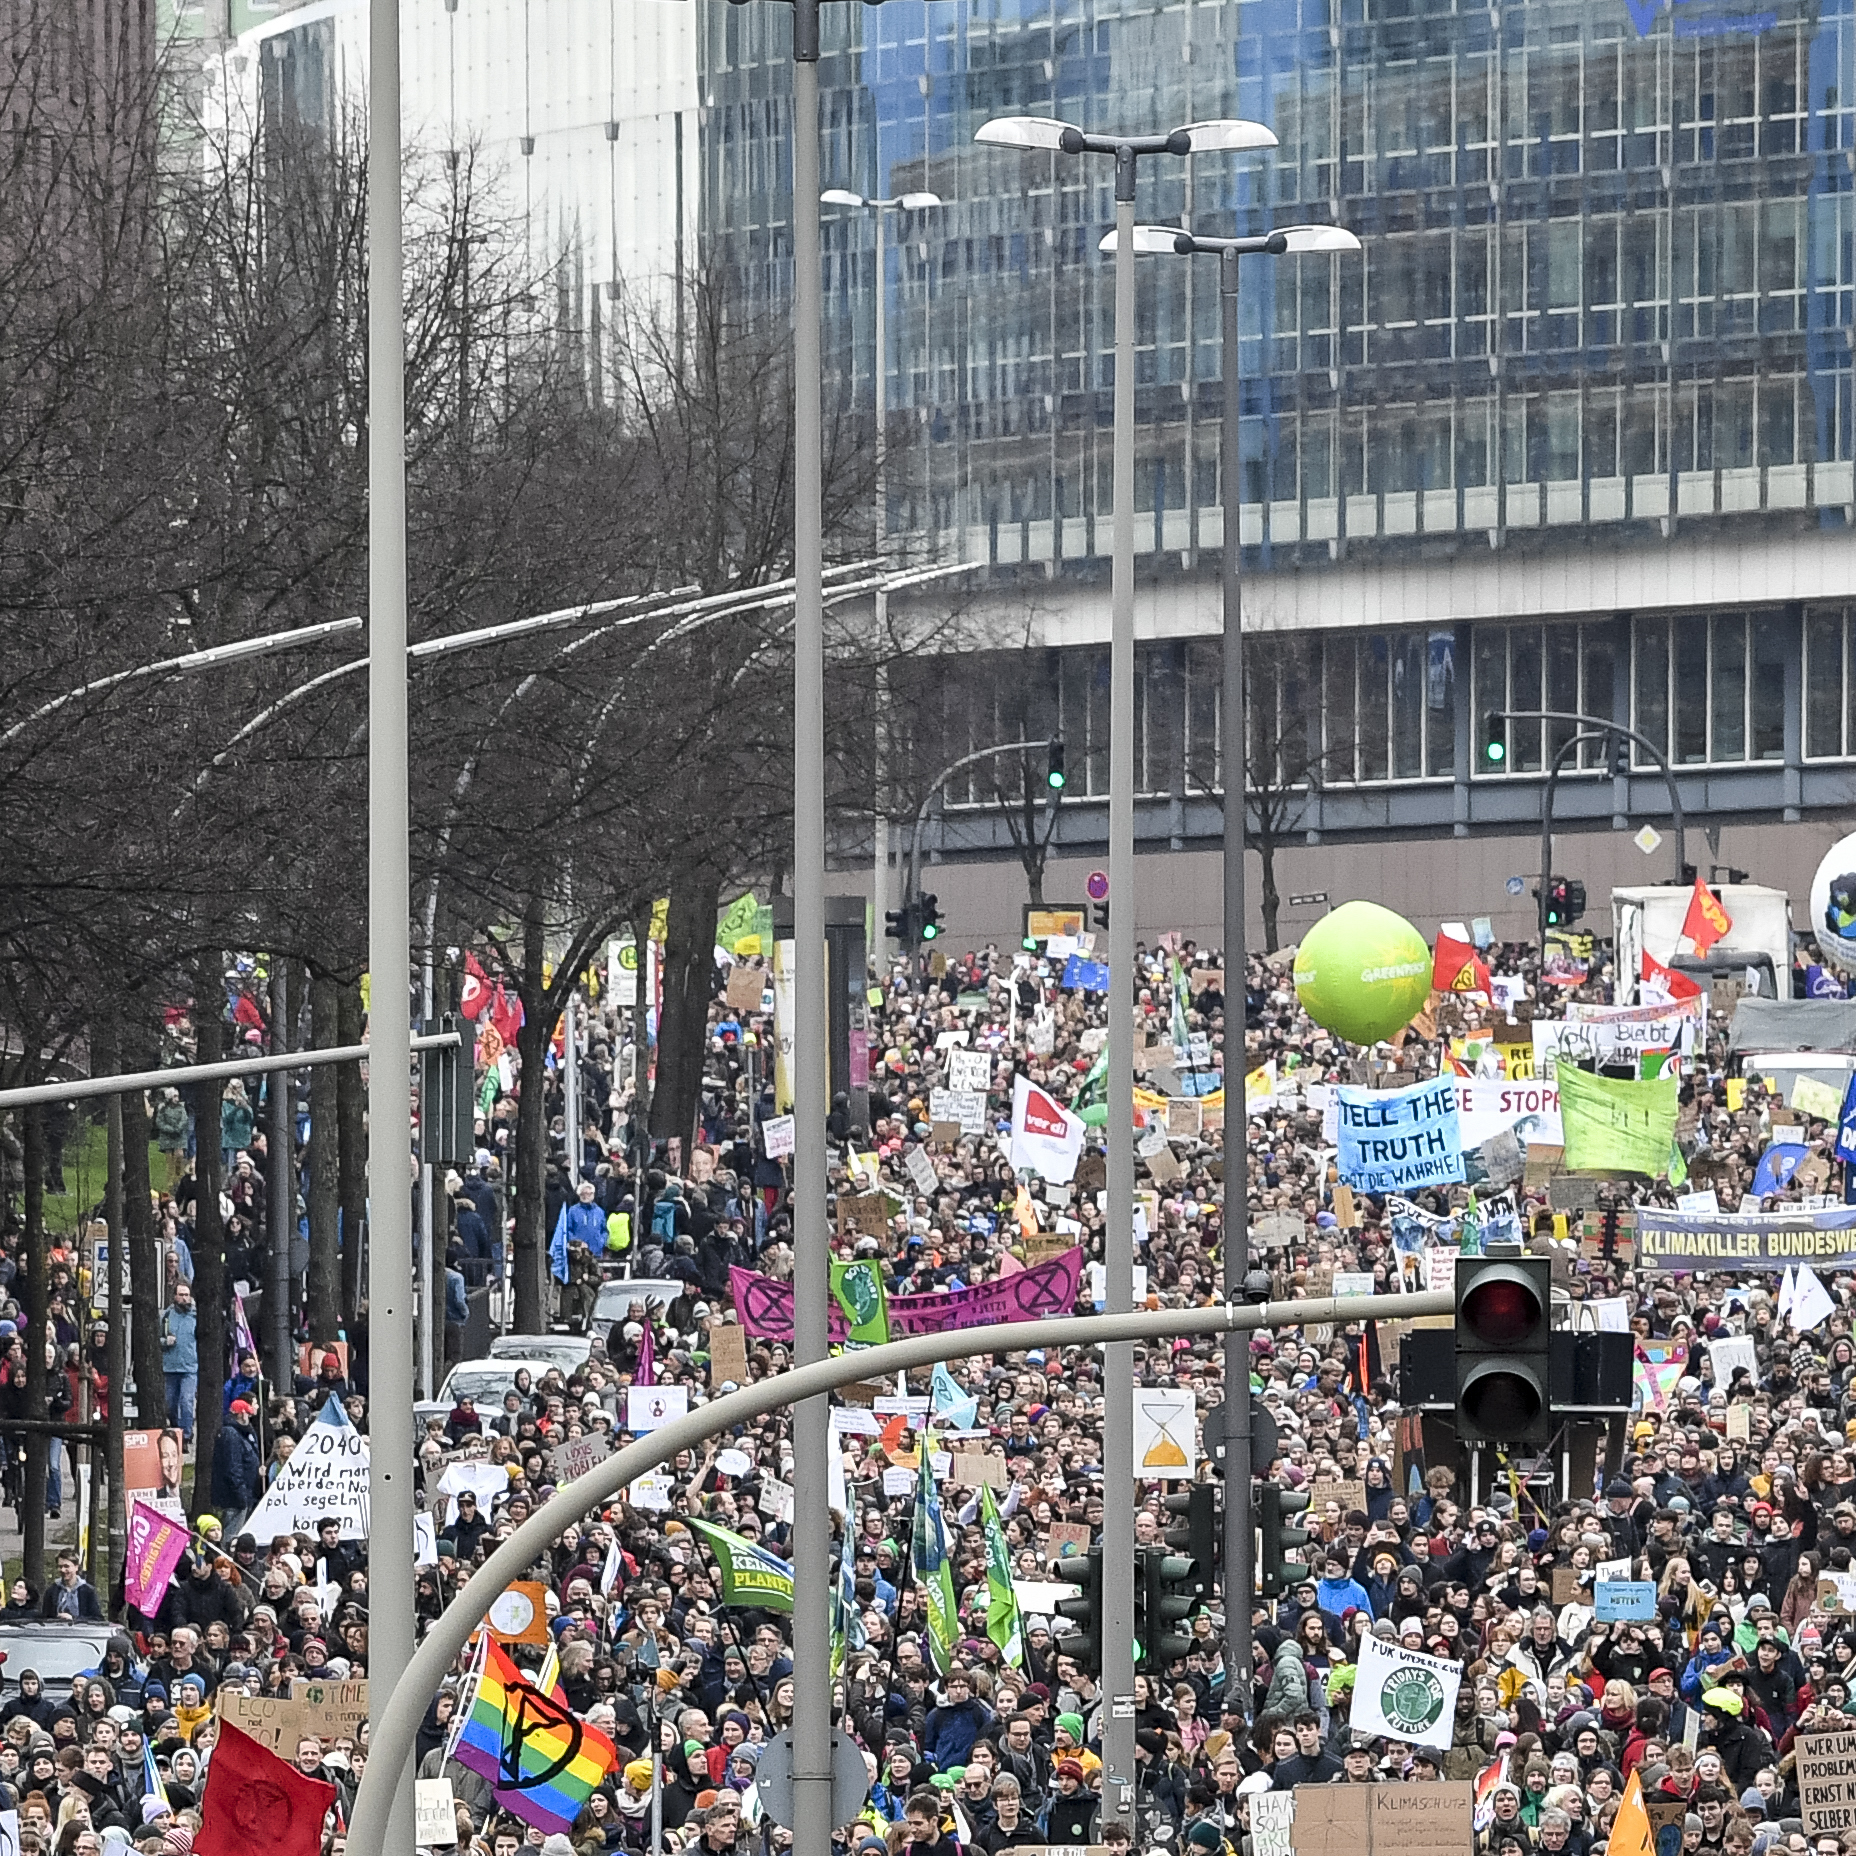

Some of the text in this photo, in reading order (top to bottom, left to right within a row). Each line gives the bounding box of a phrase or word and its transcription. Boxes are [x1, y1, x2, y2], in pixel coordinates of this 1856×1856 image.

[1342, 1087, 1455, 1129] TELL THE
[1356, 1132, 1447, 1164] TRUTH
[1367, 1169, 1390, 1189] DIE
[1642, 1229, 1762, 1257] KLIMAKILLER
[125, 1433, 148, 1447] SPD
[304, 1434, 362, 1457] 2040
[288, 1461, 331, 1479] Wird
[302, 1492, 359, 1510] segeln
[238, 1697, 277, 1718] ECO
[1392, 1714, 1435, 1736] FUTURE
[1805, 1738, 1834, 1756] WER
[1378, 1792, 1468, 1811] KLIMASCHUTZ
[1805, 1783, 1842, 1806] ERNST
[1809, 1809, 1853, 1830] SELBER
